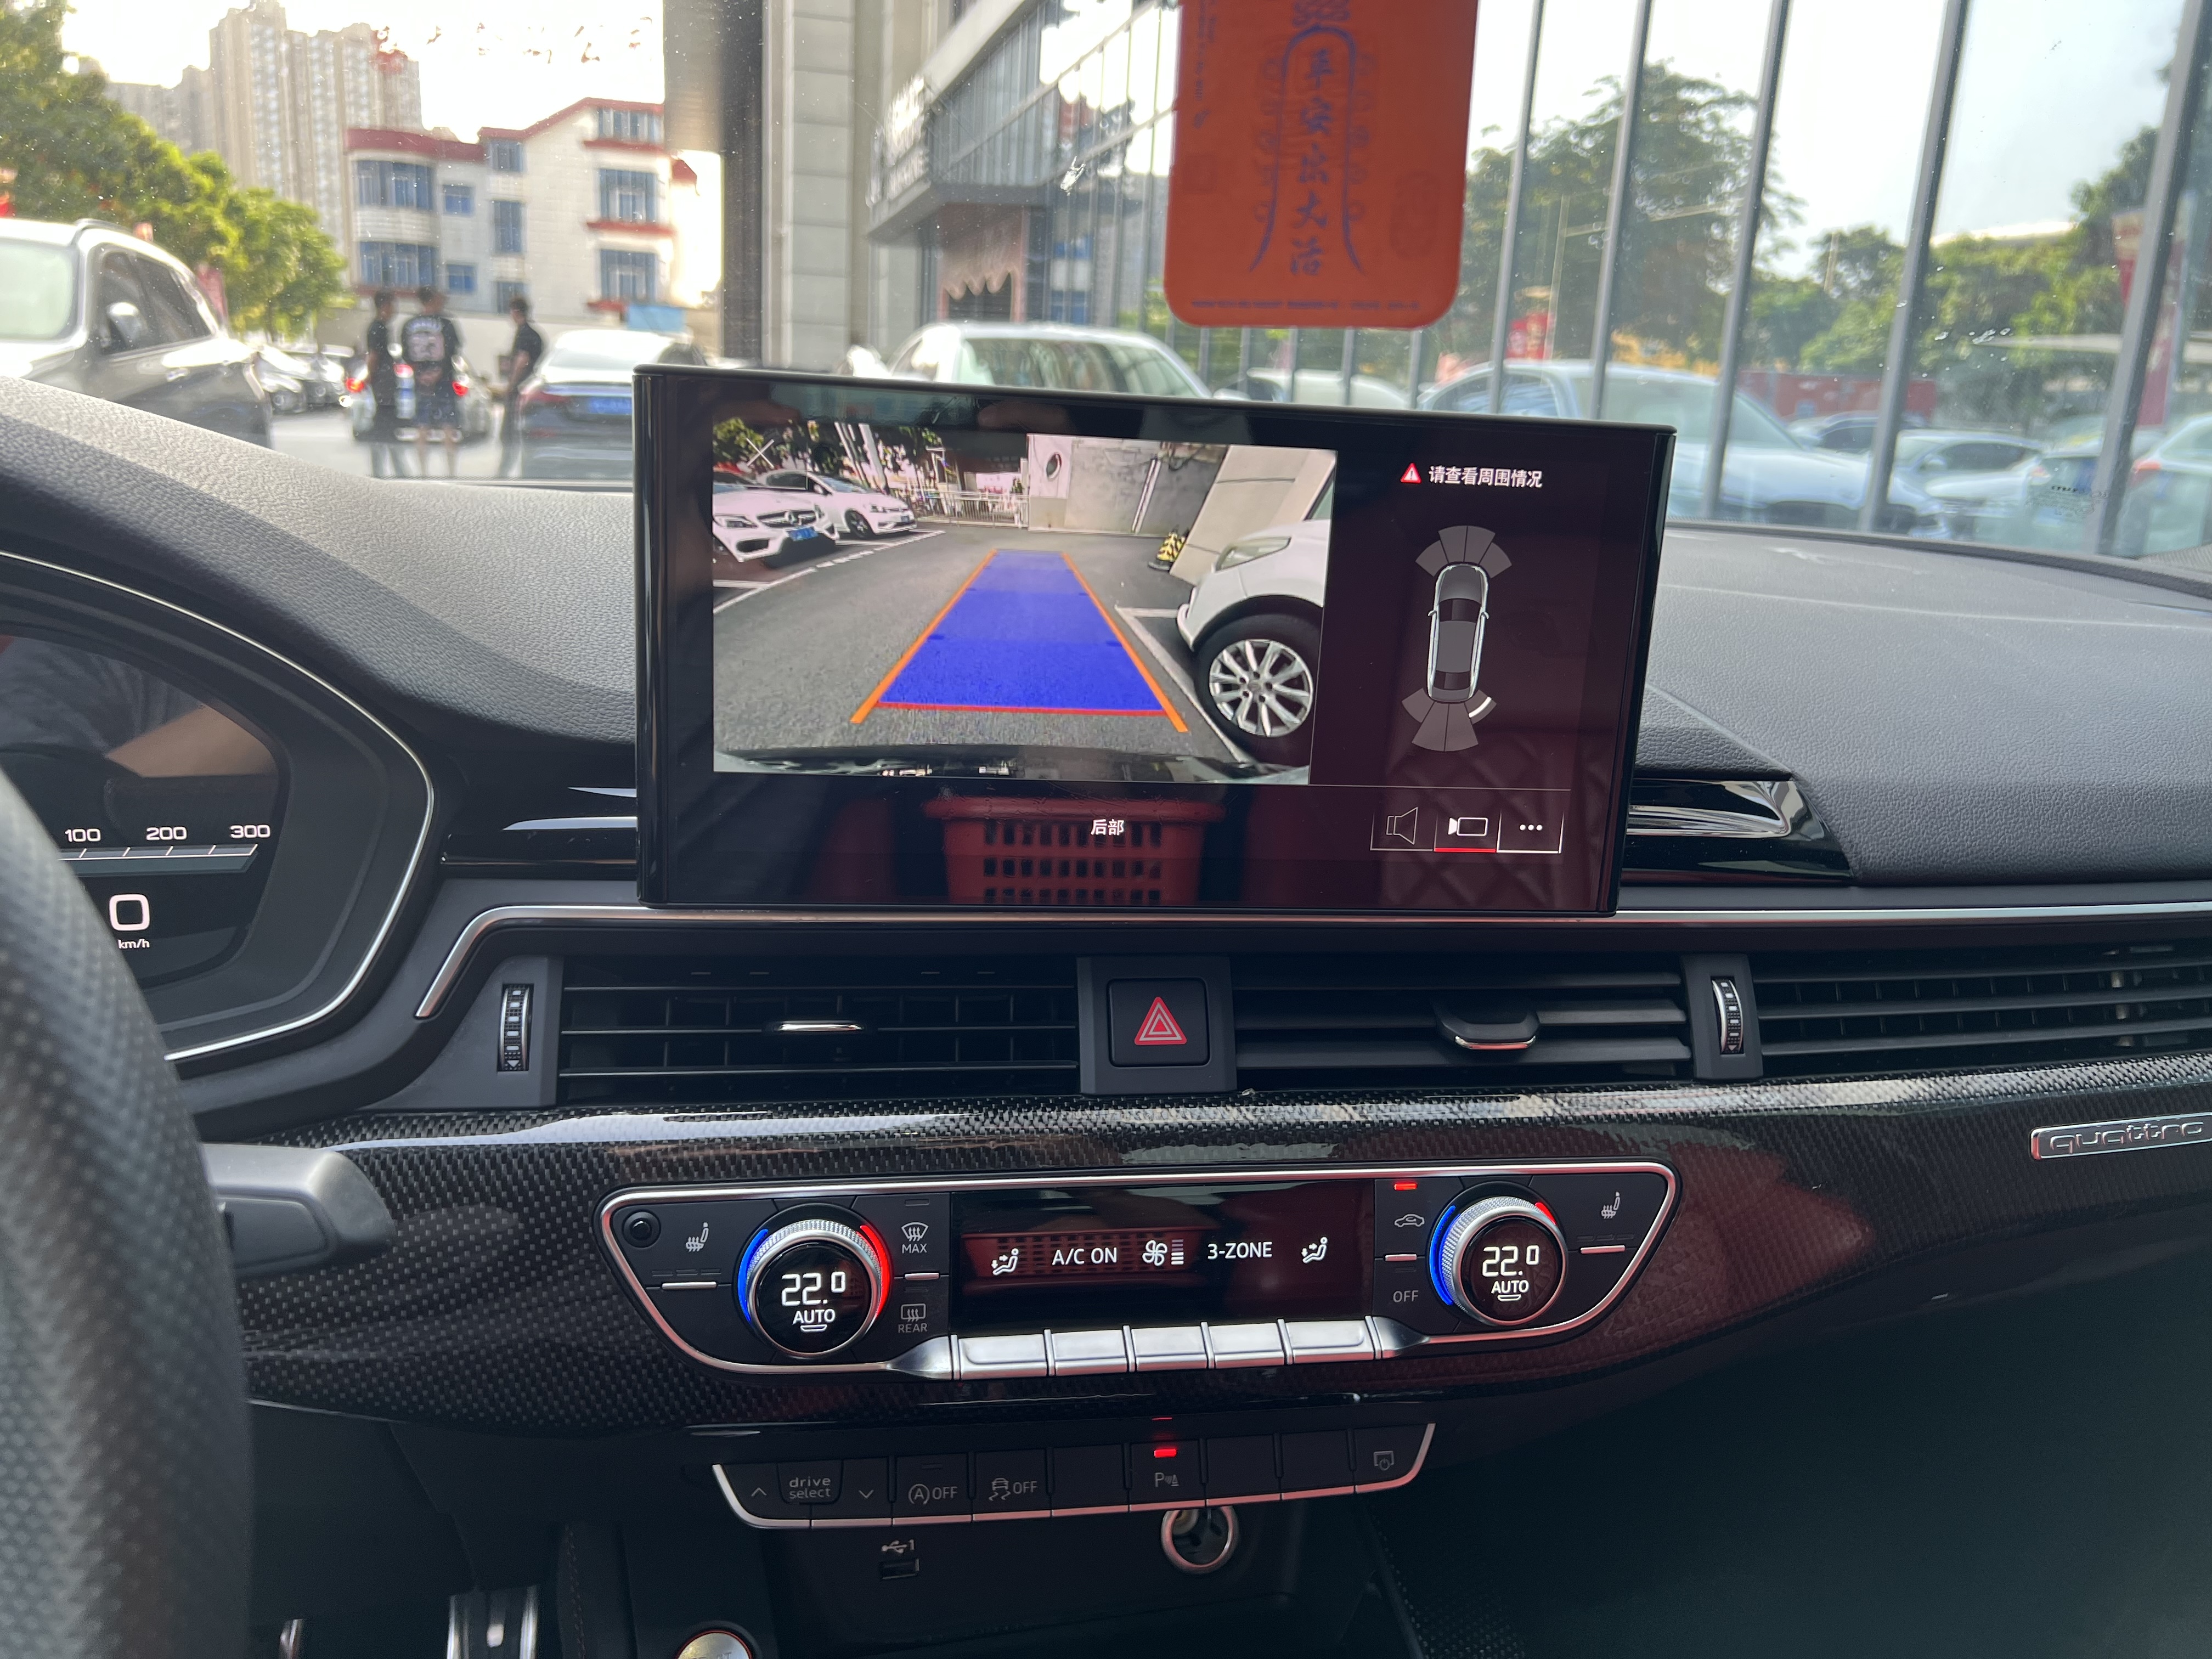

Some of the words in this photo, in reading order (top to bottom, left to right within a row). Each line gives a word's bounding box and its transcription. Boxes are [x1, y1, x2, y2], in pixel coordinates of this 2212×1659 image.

[1429, 466, 1542, 487] 请查看周围情况
[146, 827, 187, 840] 200
[230, 825, 270, 838] 300
[1091, 819, 1124, 836] 后部
[65, 829, 100, 842] 100
[109, 894, 150, 930] 0
[118, 939, 150, 949] km/h
[2049, 1121, 2204, 1154] quattro
[902, 1243, 927, 1253] MAX
[1208, 1242, 1272, 1259] 3-ZONE
[1052, 1249, 1084, 1265] A/C
[1091, 1248, 1116, 1263] ON
[1491, 1280, 1529, 1294] AUTO
[1393, 1290, 1418, 1302] OFF
[793, 1309, 835, 1324] AUTO
[899, 1323, 927, 1333] REAR
[789, 1476, 831, 1488] drive
[1013, 1481, 1037, 1494] OFF
[789, 1487, 830, 1499] select
[933, 1487, 957, 1499] OFF
